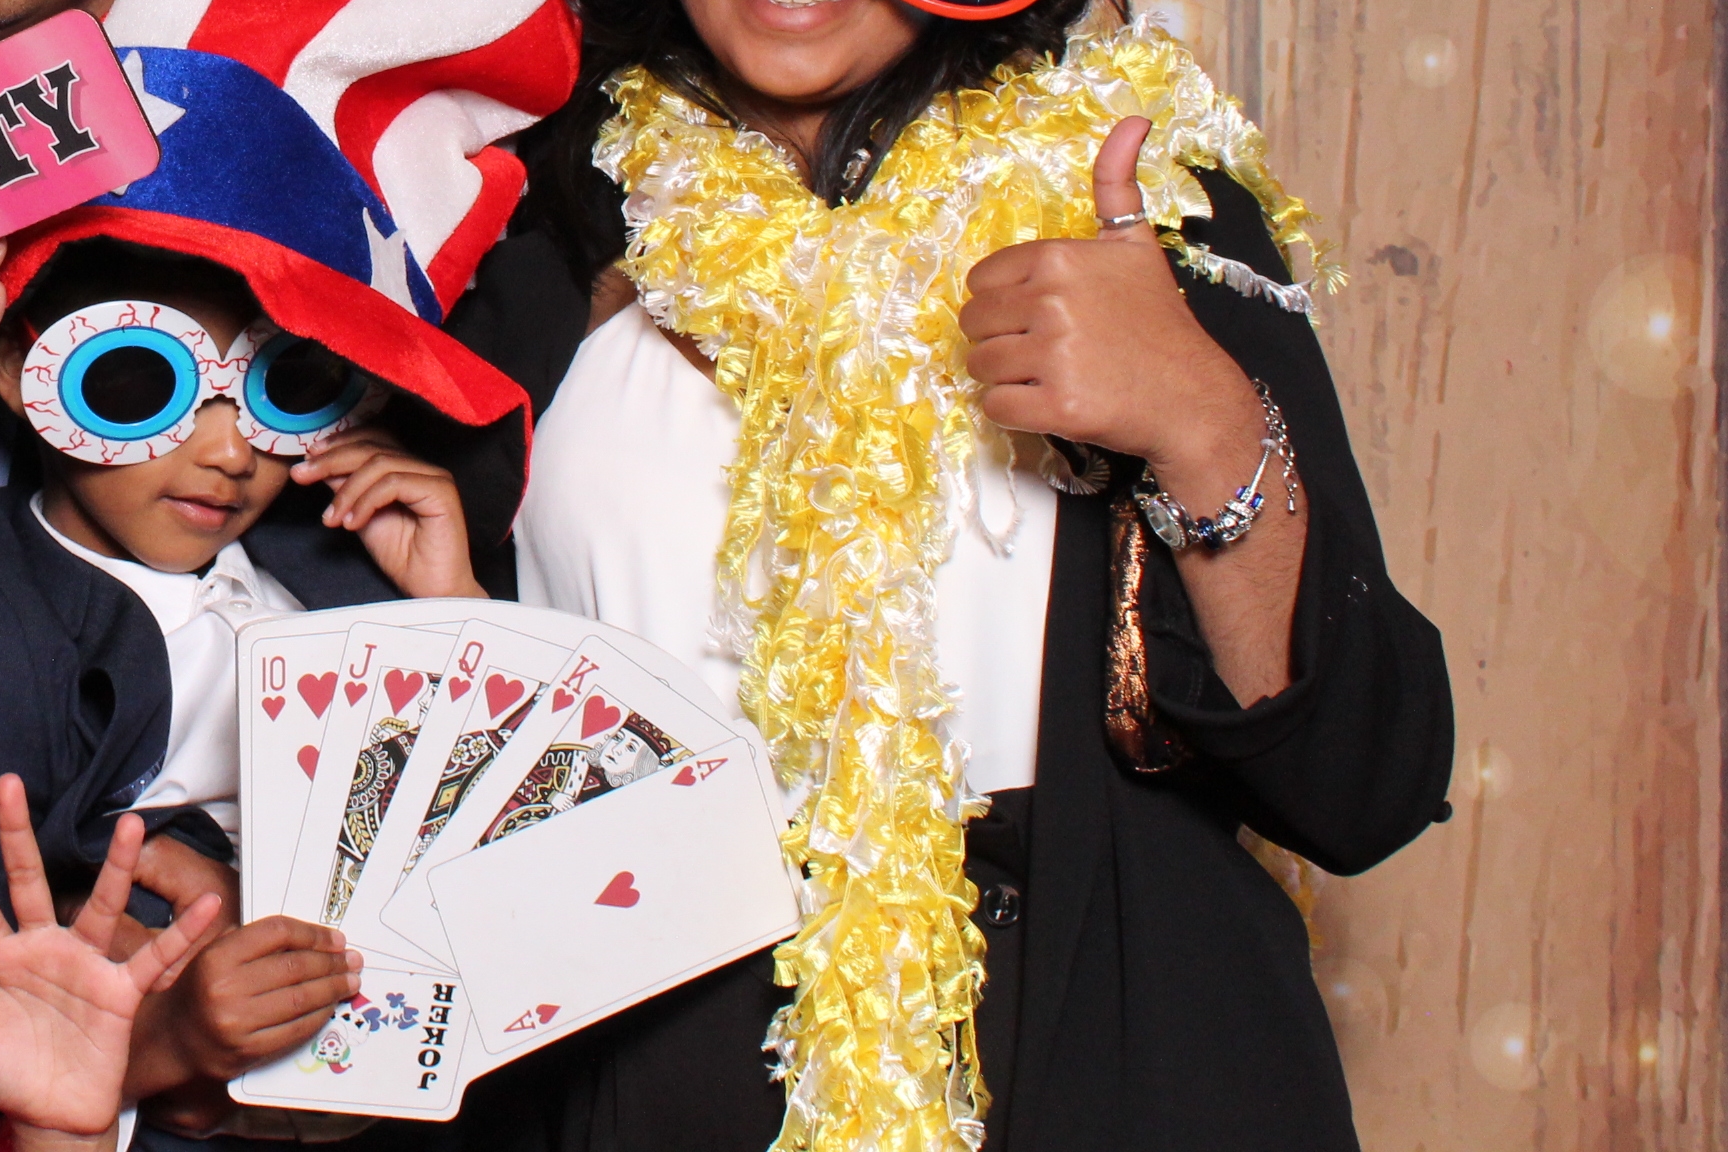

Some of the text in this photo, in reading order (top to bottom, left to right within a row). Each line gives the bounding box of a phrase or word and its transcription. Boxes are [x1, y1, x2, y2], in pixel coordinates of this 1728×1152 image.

[261, 655, 286, 692] 10
[350, 644, 377, 679] J
[457, 641, 484, 679] Q
[563, 656, 599, 694] K
[697, 758, 728, 780] A
[417, 982, 456, 1090] JOKER
[503, 1009, 536, 1033] A
